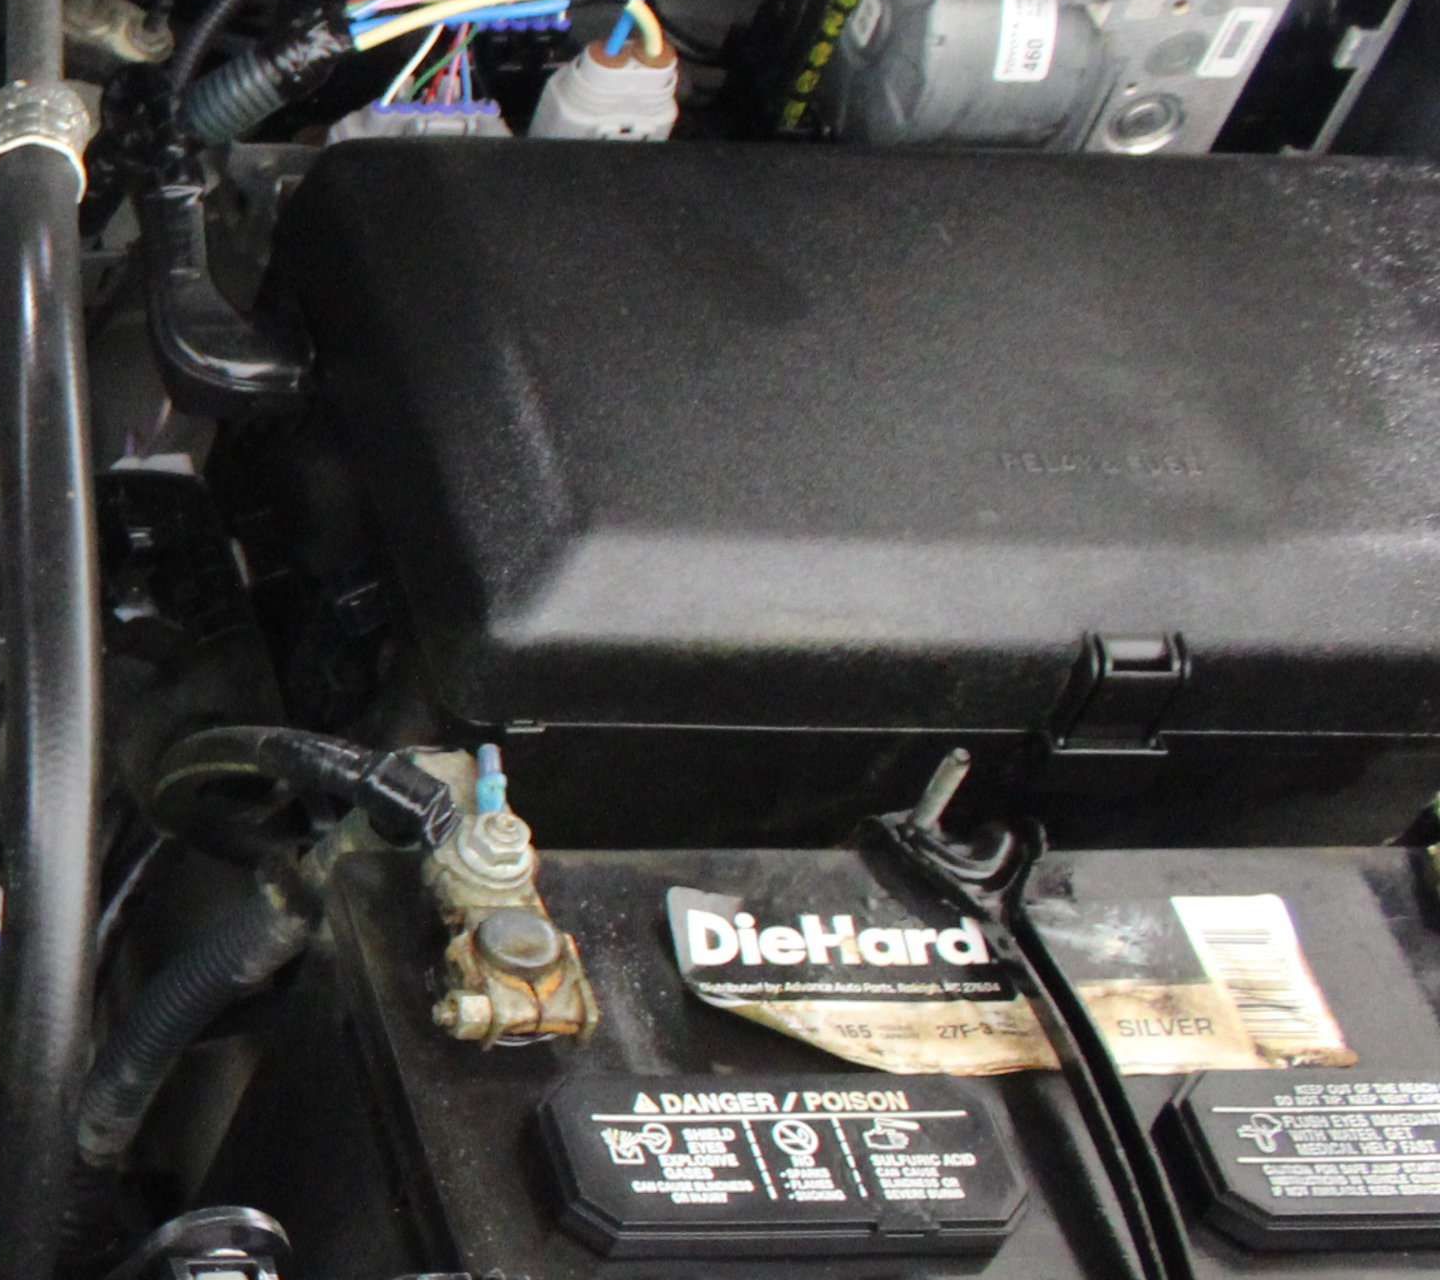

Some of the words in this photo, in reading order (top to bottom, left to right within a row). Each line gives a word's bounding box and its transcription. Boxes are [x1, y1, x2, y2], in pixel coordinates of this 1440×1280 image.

[1023, 38, 1044, 71] 460
[686, 908, 991, 967] DieHard
[834, 982, 862, 993] Auto
[836, 1024, 873, 1039] 165
[1116, 1017, 1216, 1038] SILVER
[659, 1091, 779, 1114] DANGER
[802, 1090, 910, 1112] POISON
[1282, 1115, 1330, 1128] FLUSH
[1330, 1114, 1370, 1128] EYES
[681, 1128, 737, 1142] SHIELD
[1288, 1129, 1328, 1142] WITH
[1383, 1127, 1414, 1140] GET
[685, 1141, 728, 1155] EYES
[1295, 1142, 1359, 1156] MEDICAL
[1359, 1141, 1397, 1155] HELP
[1399, 1140, 1437, 1154] FAST
[657, 1153, 740, 1168] EXPLOSIVE
[869, 1153, 942, 1167] SULFURIC
[943, 1152, 977, 1167] ACID
